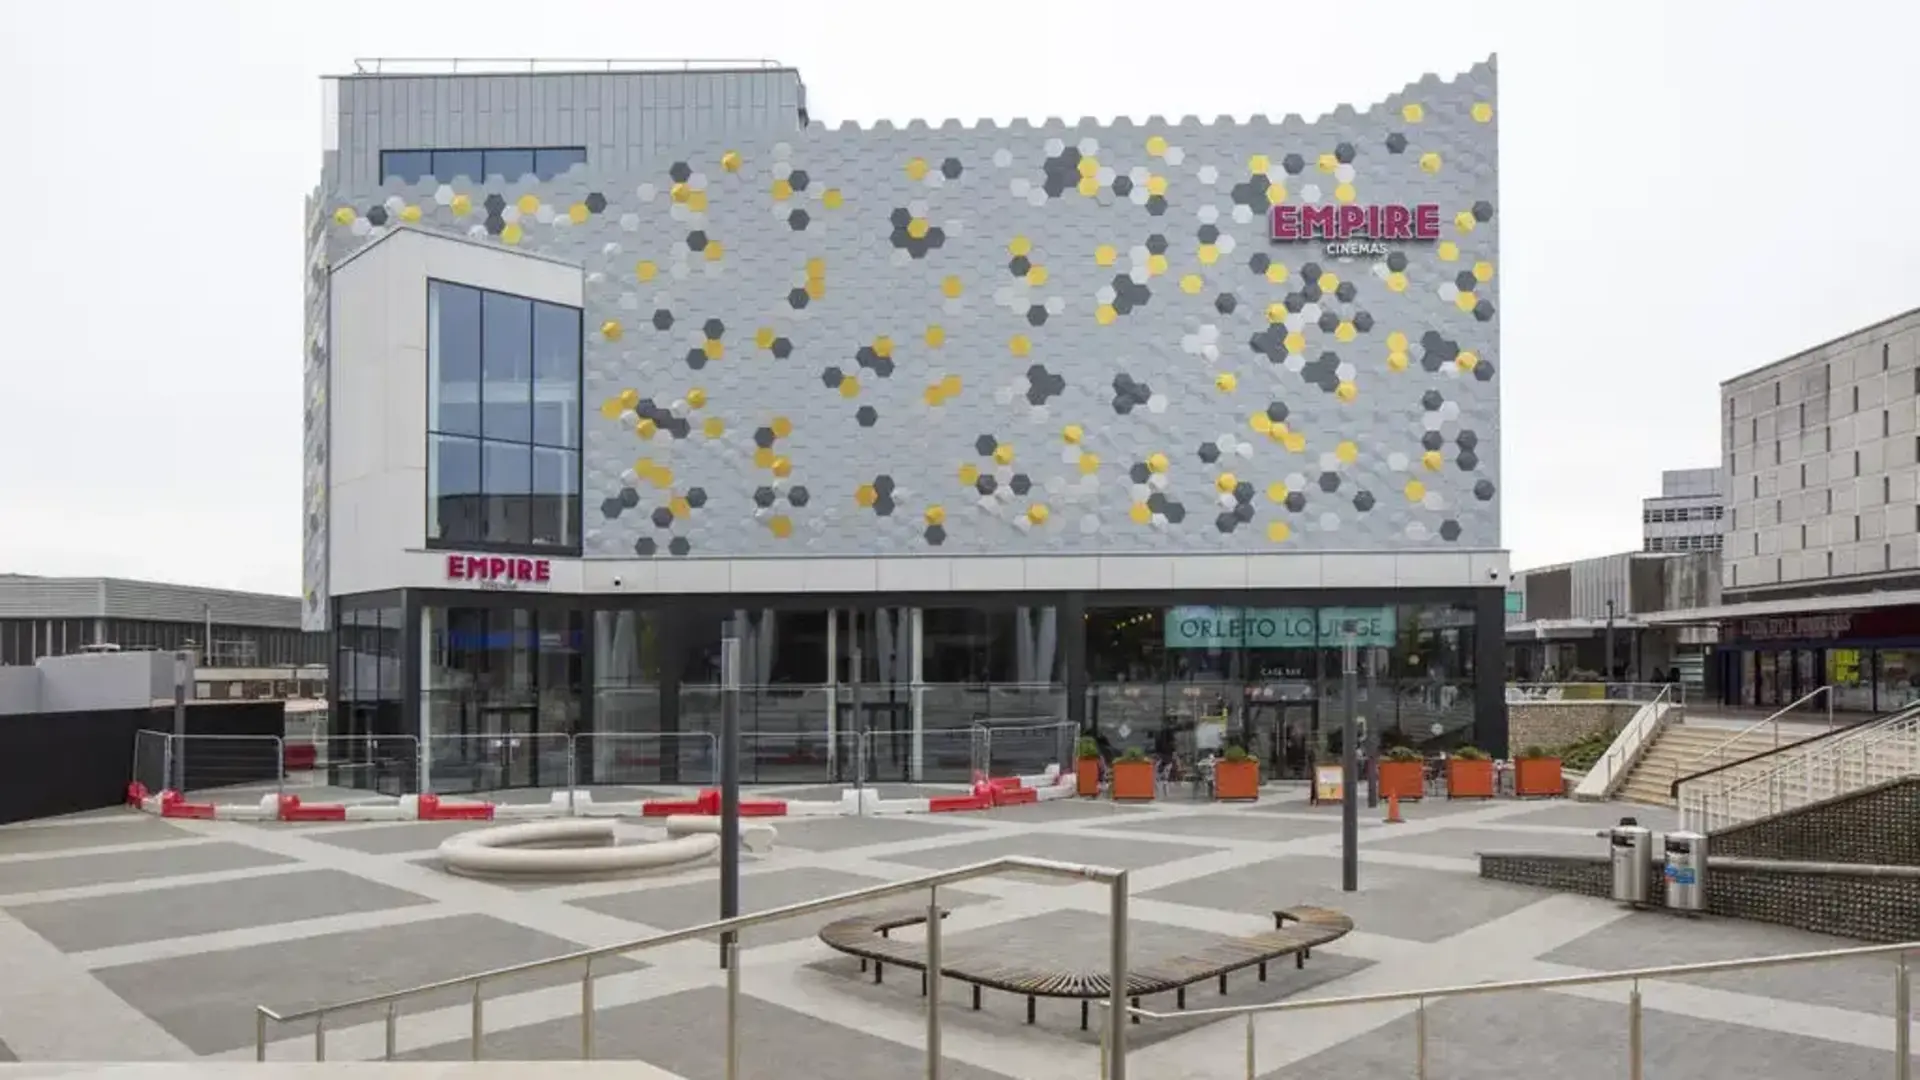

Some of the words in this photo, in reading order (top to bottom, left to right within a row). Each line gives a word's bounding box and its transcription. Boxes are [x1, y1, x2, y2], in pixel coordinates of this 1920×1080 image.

[1272, 204, 1441, 239] EMPIRE
[1326, 243, 1389, 255] CINEMAS
[447, 554, 550, 581] EMPIRE
[1180, 617, 1276, 639] ORLETO
